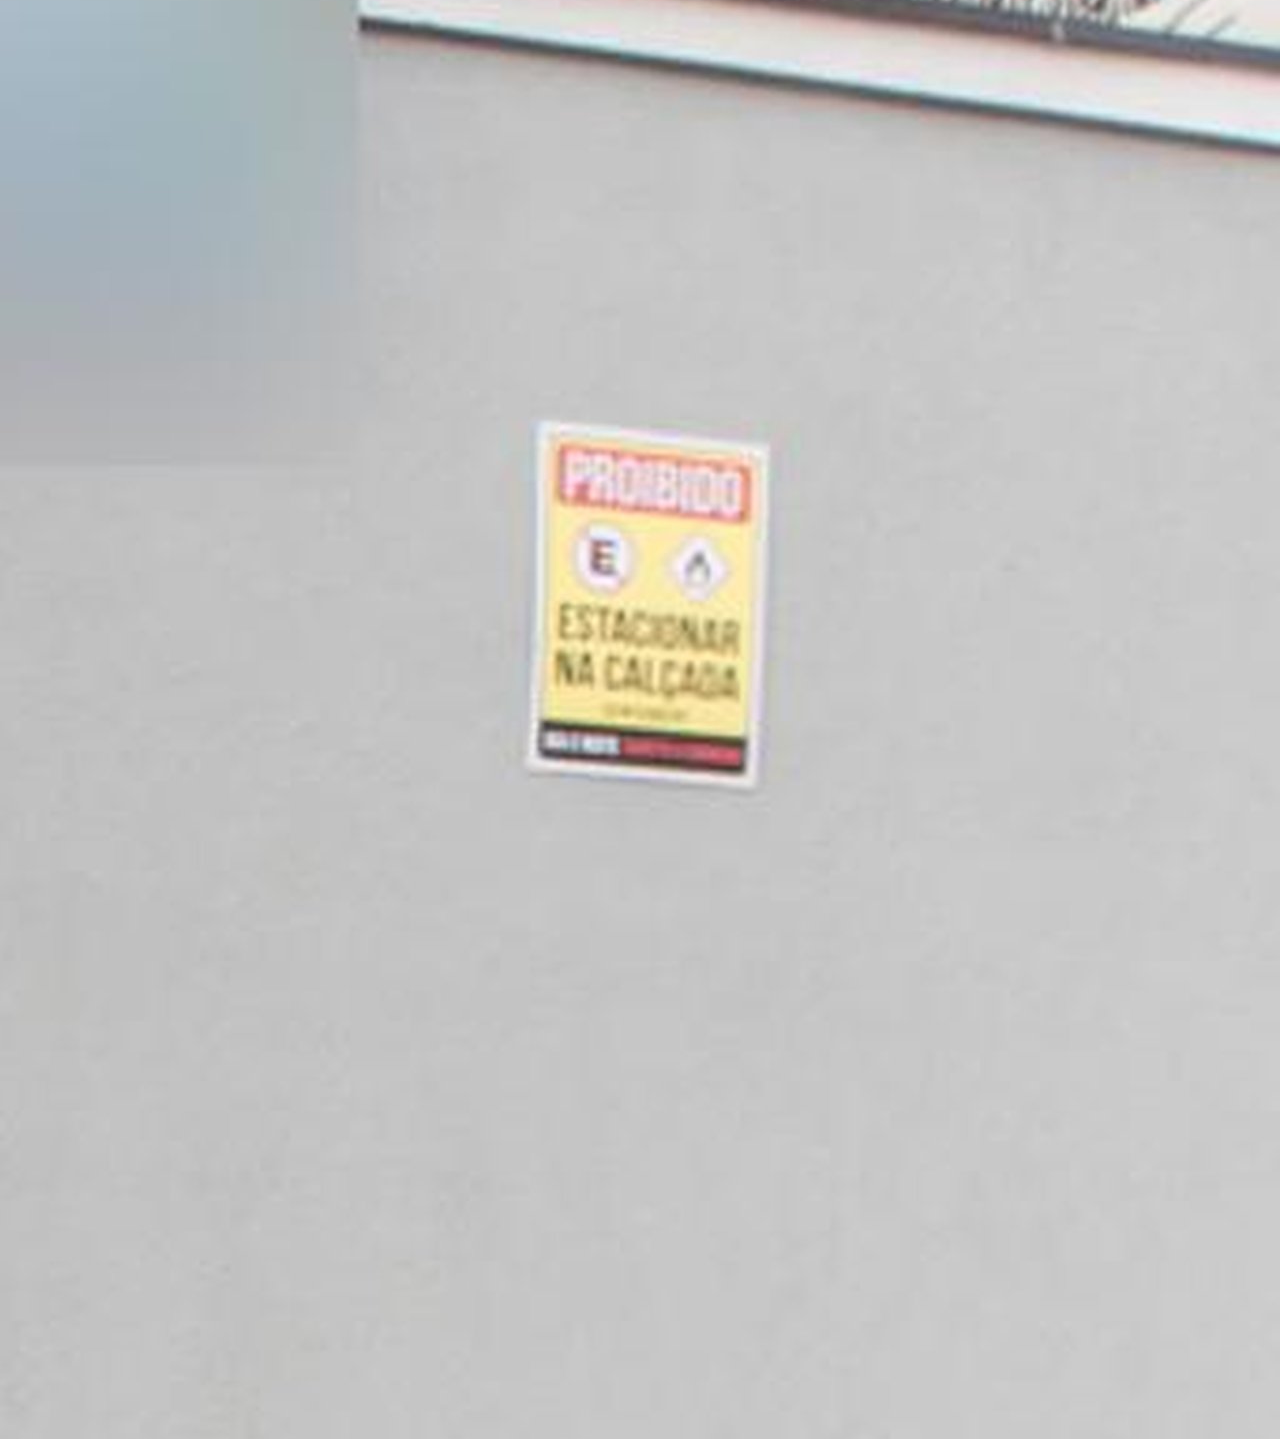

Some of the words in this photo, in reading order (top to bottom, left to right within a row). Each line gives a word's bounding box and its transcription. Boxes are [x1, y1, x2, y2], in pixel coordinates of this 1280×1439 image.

[564, 451, 741, 520] PROIBIDO
[589, 538, 617, 576] E
[558, 603, 741, 655] ESTACIONAR
[555, 651, 594, 687] NA
[604, 655, 740, 701] CALÇADA
